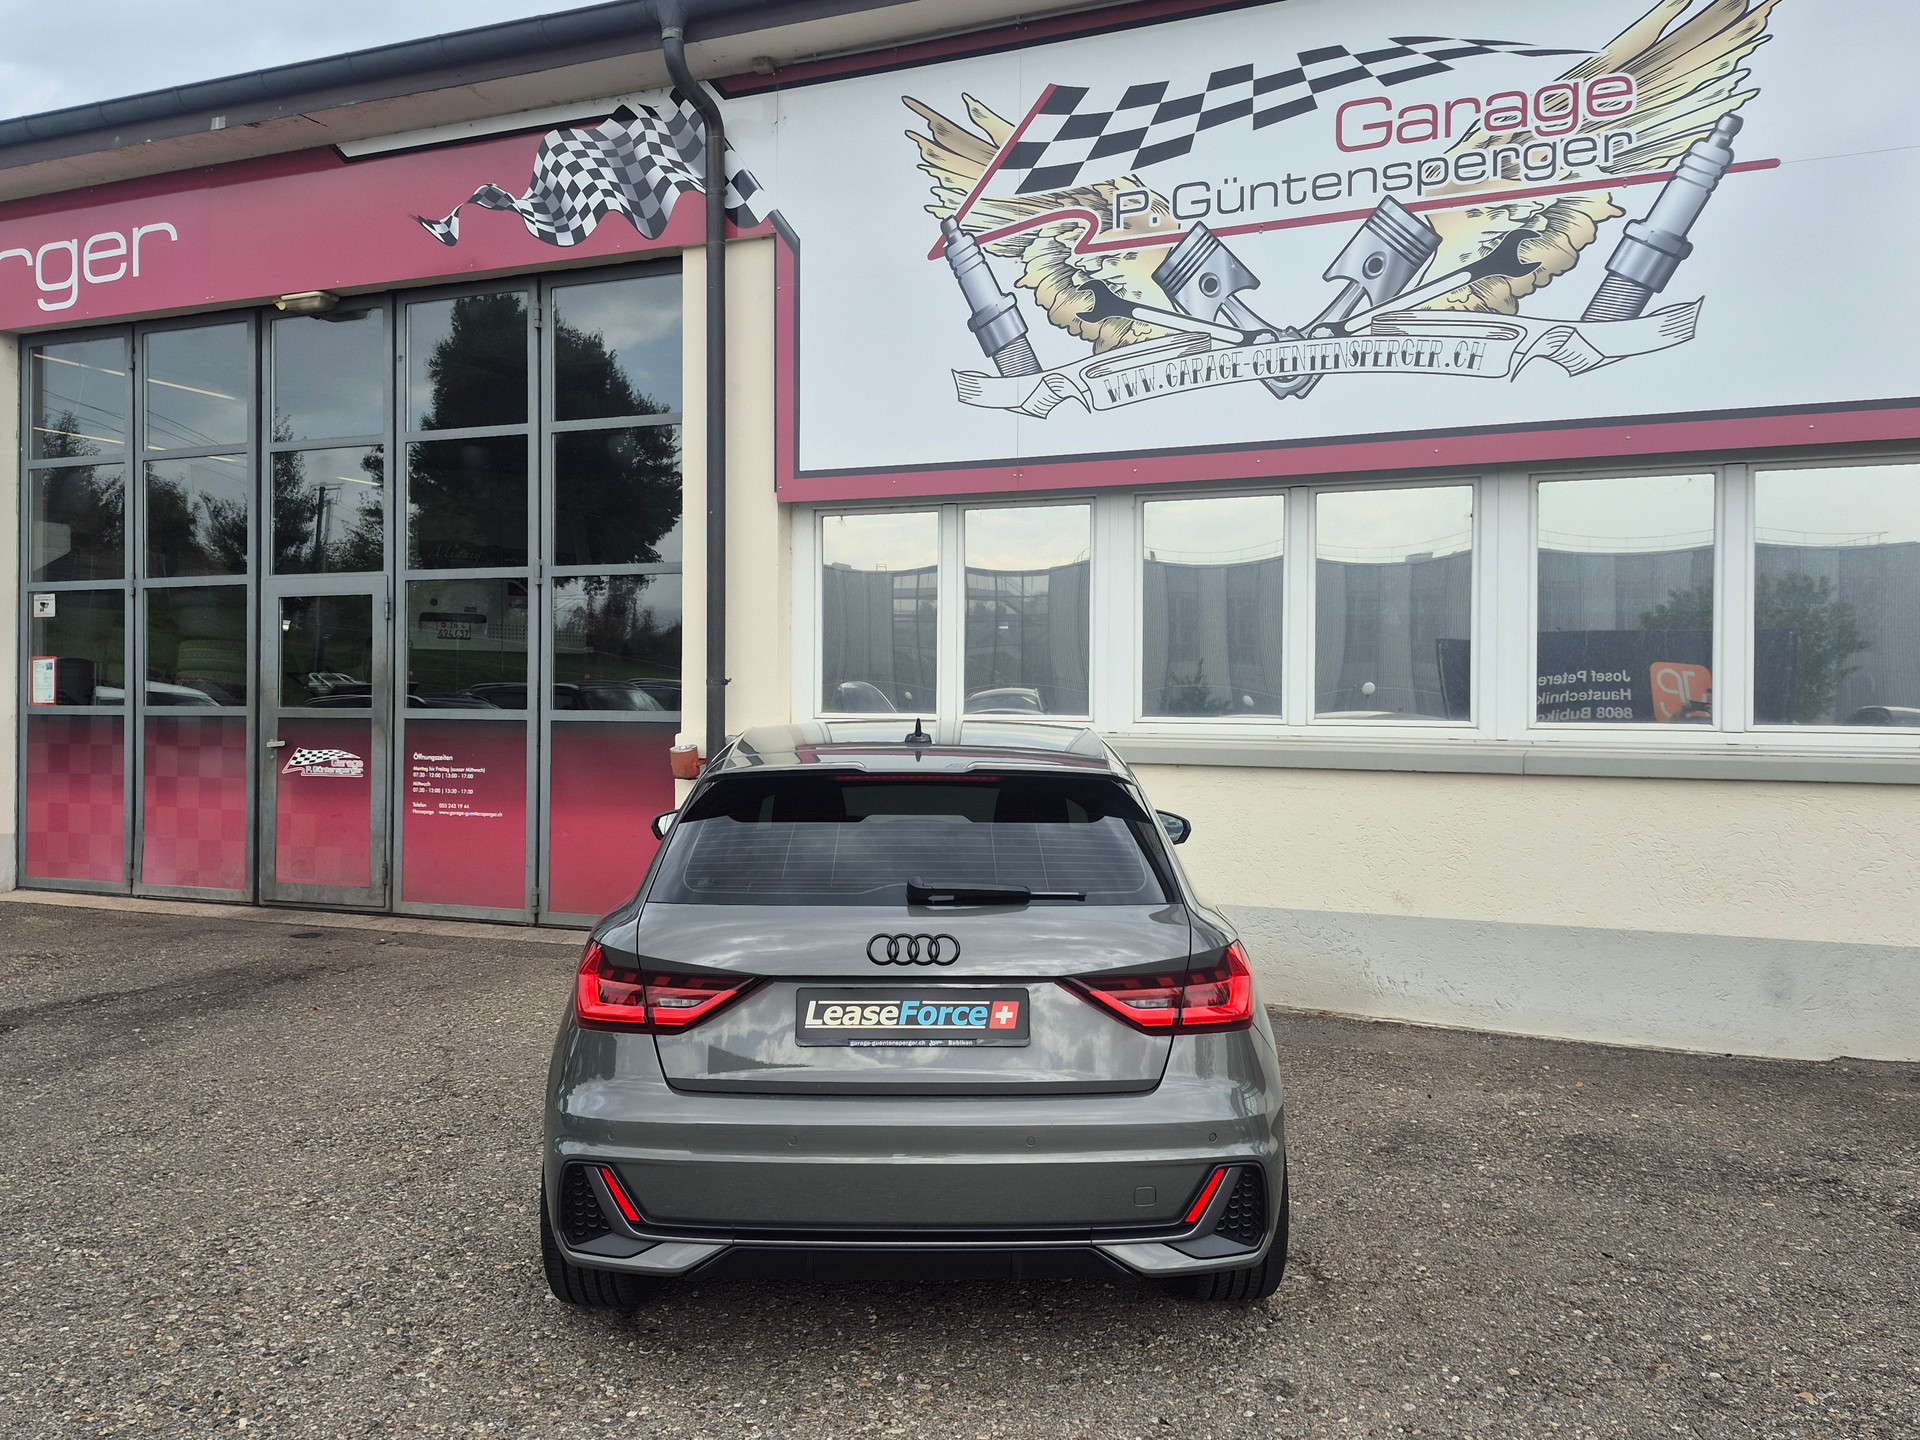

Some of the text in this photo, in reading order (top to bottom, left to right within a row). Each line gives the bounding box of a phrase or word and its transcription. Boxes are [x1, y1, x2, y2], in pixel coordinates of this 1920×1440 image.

[1336, 73, 1634, 153] Garage
[1115, 131, 1634, 229] P. Güntensperger
[1104, 338, 1488, 404] WWW.GARAGE-GUENTENSPERGER.CH
[413, 752, 454, 761] Öffnungszeiten
[805, 1001, 988, 1026] LeaseForce
